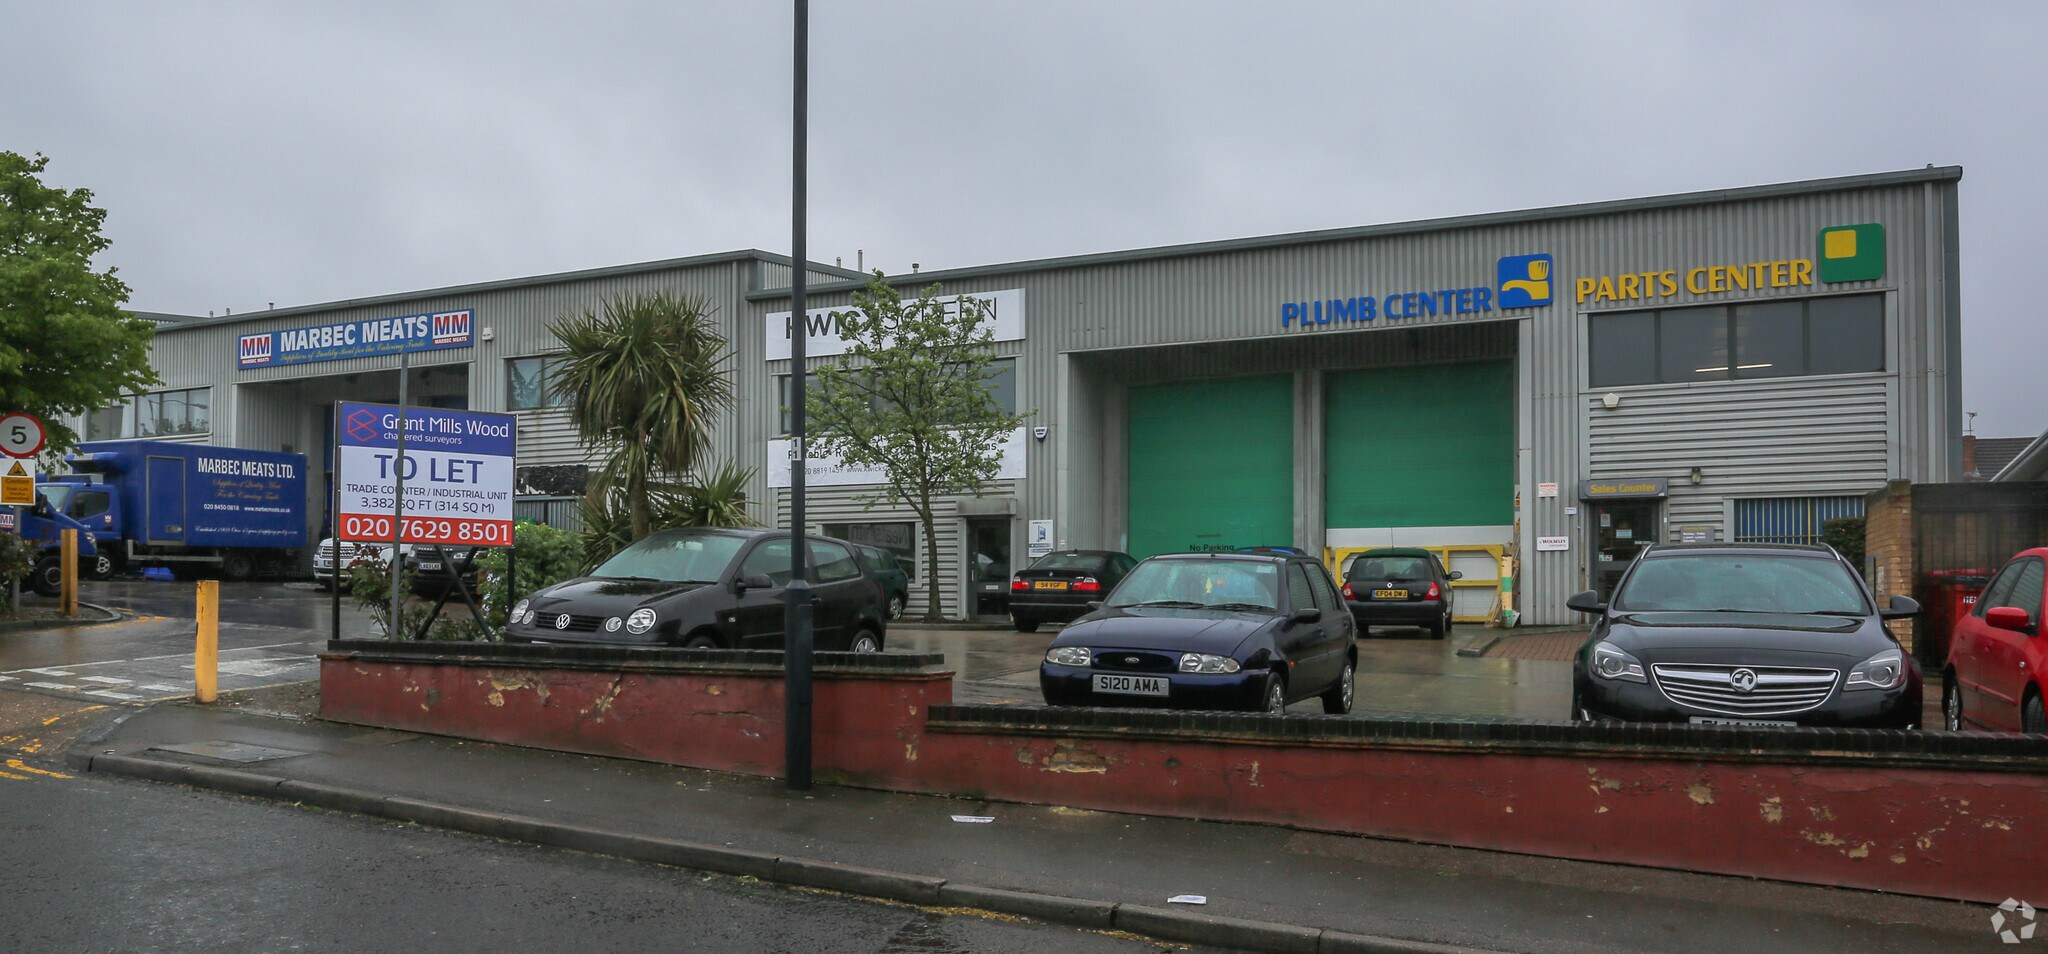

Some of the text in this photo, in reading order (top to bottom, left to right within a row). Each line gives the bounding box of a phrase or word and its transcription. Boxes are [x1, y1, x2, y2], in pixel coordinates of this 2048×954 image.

[1576, 259, 1812, 304] PARTS CENTER
[1282, 286, 1492, 328] PLUMB CENTER
[280, 316, 428, 352] MARBEC MEATS
[434, 314, 468, 336] MM
[242, 336, 270, 356] MM
[11, 426, 27, 444] 5
[382, 414, 509, 438] Grant Mills Wood
[384, 432, 462, 445] chaered surveyors
[793, 439, 797, 447] 1
[198, 458, 295, 478] MARBEC MEATS LTD.
[374, 454, 483, 484] TO LET
[347, 484, 378, 493] TRADE
[381, 486, 425, 496] CONTER
[433, 489, 485, 499] INDUSTRIAL
[487, 492, 507, 500] UNIT
[1590, 483, 1656, 494] Sales Counter
[361, 497, 495, 514] 3,382 SQ FT (314 SQ M)
[346, 517, 508, 541] 020 7629 8501
[1100, 676, 1159, 692] S120 AMA
